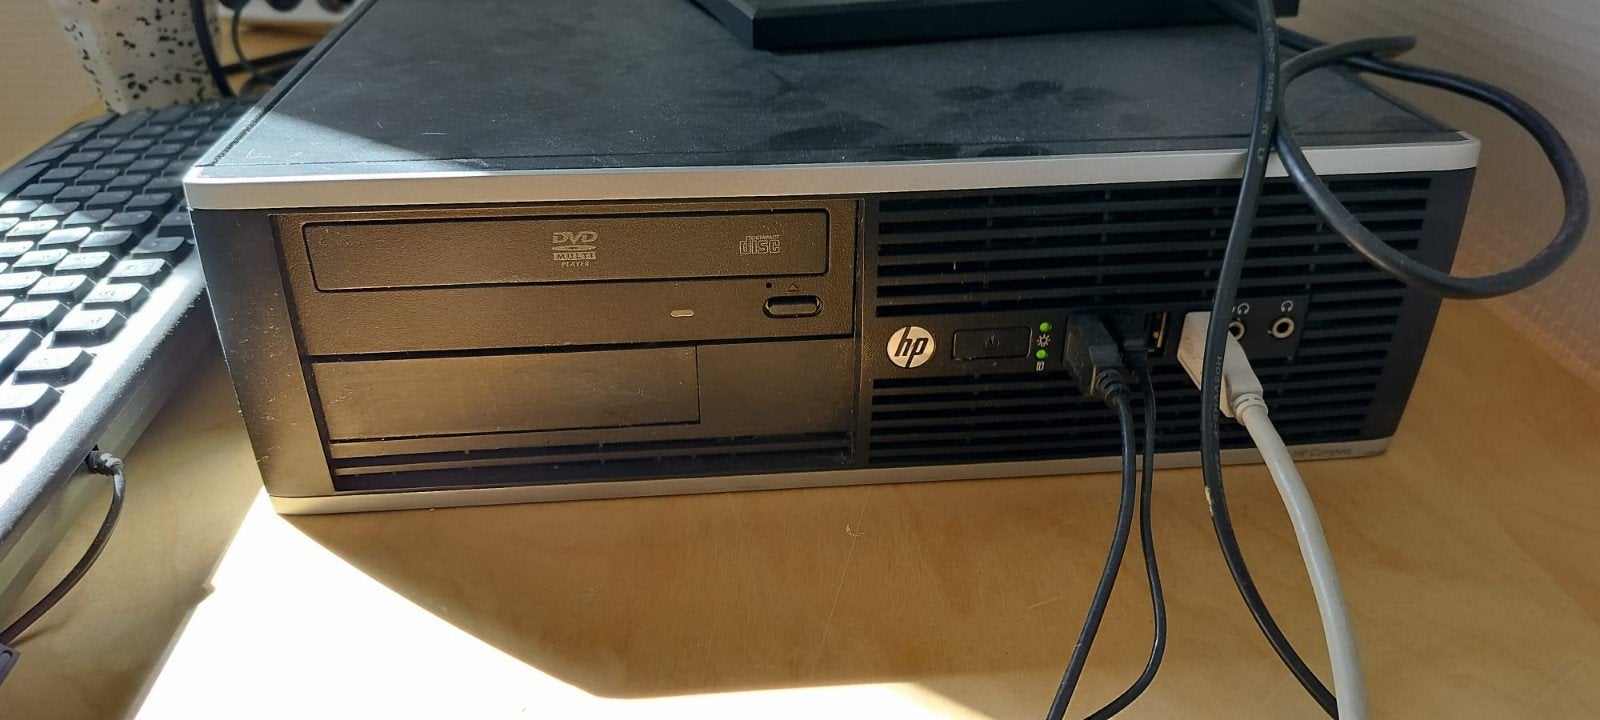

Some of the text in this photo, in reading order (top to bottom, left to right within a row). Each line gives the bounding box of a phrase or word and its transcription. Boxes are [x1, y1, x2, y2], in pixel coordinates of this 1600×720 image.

[553, 231, 598, 244] DVD
[554, 252, 597, 260] MULTI
[894, 326, 929, 368] hp
